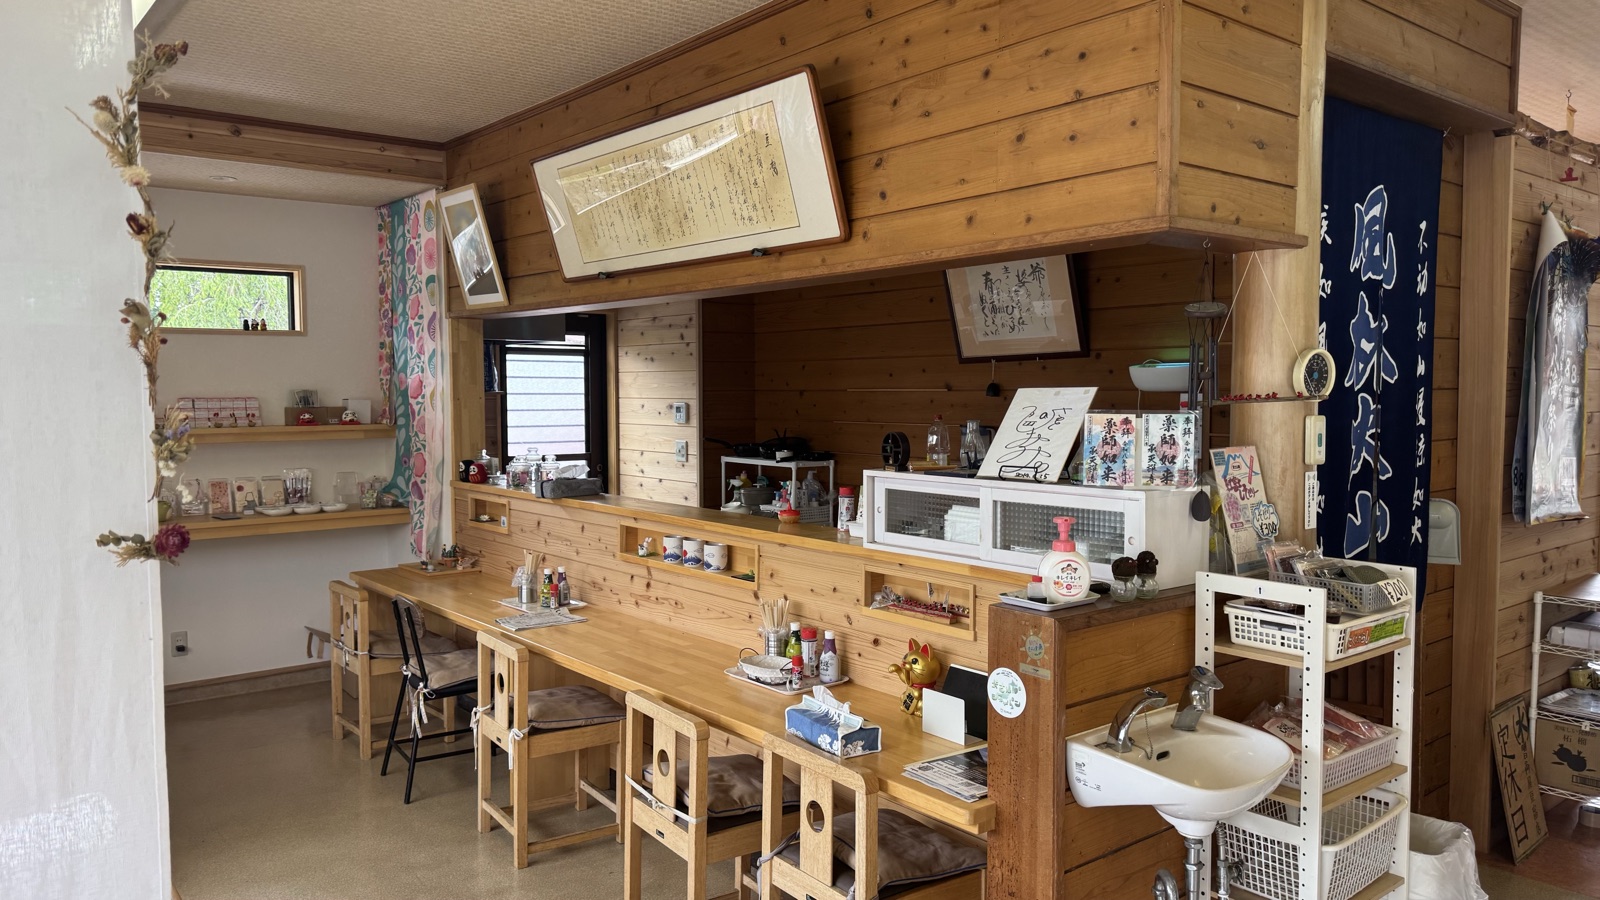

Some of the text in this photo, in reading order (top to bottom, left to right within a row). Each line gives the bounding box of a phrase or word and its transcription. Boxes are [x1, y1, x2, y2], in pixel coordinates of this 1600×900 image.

[1344, 184, 1398, 559] 風林火山
[1101, 418, 1119, 482] 薬師如来
[1160, 415, 1178, 485] 薬師如来
[1259, 521, 1278, 536] ¥300
[1381, 578, 1408, 603] ¥200
[1497, 723, 1528, 847] 定休日
